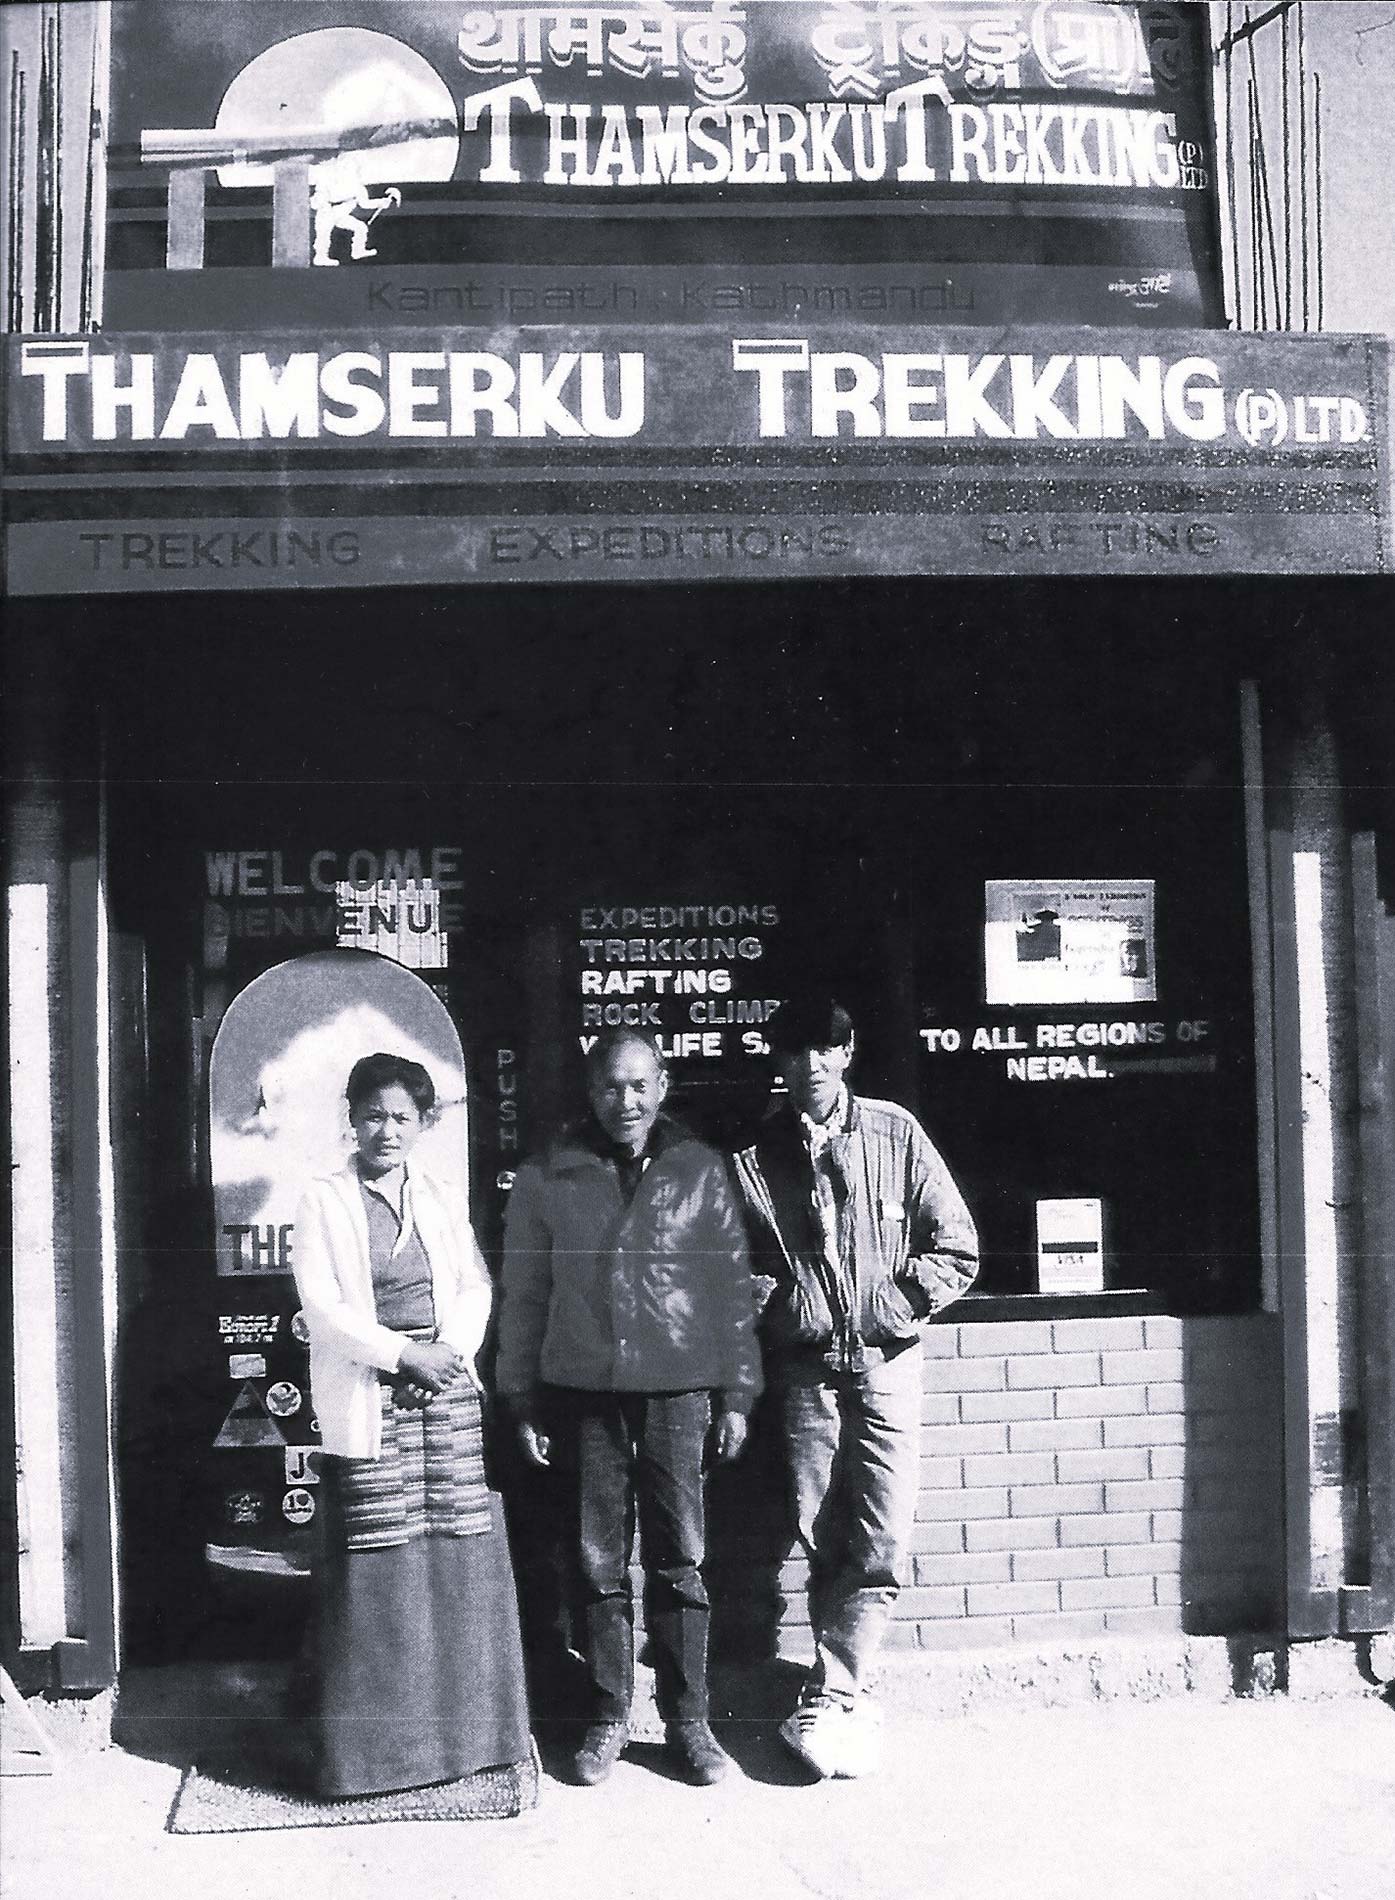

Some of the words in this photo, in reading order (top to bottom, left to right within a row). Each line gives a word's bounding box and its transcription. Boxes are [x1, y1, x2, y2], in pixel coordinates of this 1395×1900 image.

[463, 76, 886, 187] THAMSERKU
[883, 75, 1179, 188] TREKKING
[20, 341, 645, 441] THAMSERKU
[733, 339, 1228, 441] TREKKING
[1234, 388, 1289, 447] (P)
[1294, 396, 1376, 444] LTD.
[80, 529, 362, 571] TREKKING
[489, 525, 847, 562] EXPEDITIONS
[982, 521, 1222, 557] RAFTING
[205, 847, 465, 897] WELCOME
[579, 904, 780, 930] EXPEDITIONS
[579, 936, 763, 963] TREKKING
[581, 969, 733, 995] RAFTING
[582, 1002, 662, 1026] ROCK
[920, 1029, 961, 1052] TO
[972, 1026, 1028, 1050] ALL
[1036, 1022, 1166, 1048] REGIONS
[1176, 1020, 1209, 1042] OF
[1006, 1055, 1115, 1081] NEPAL.
[496, 1048, 519, 1151] PUSH
